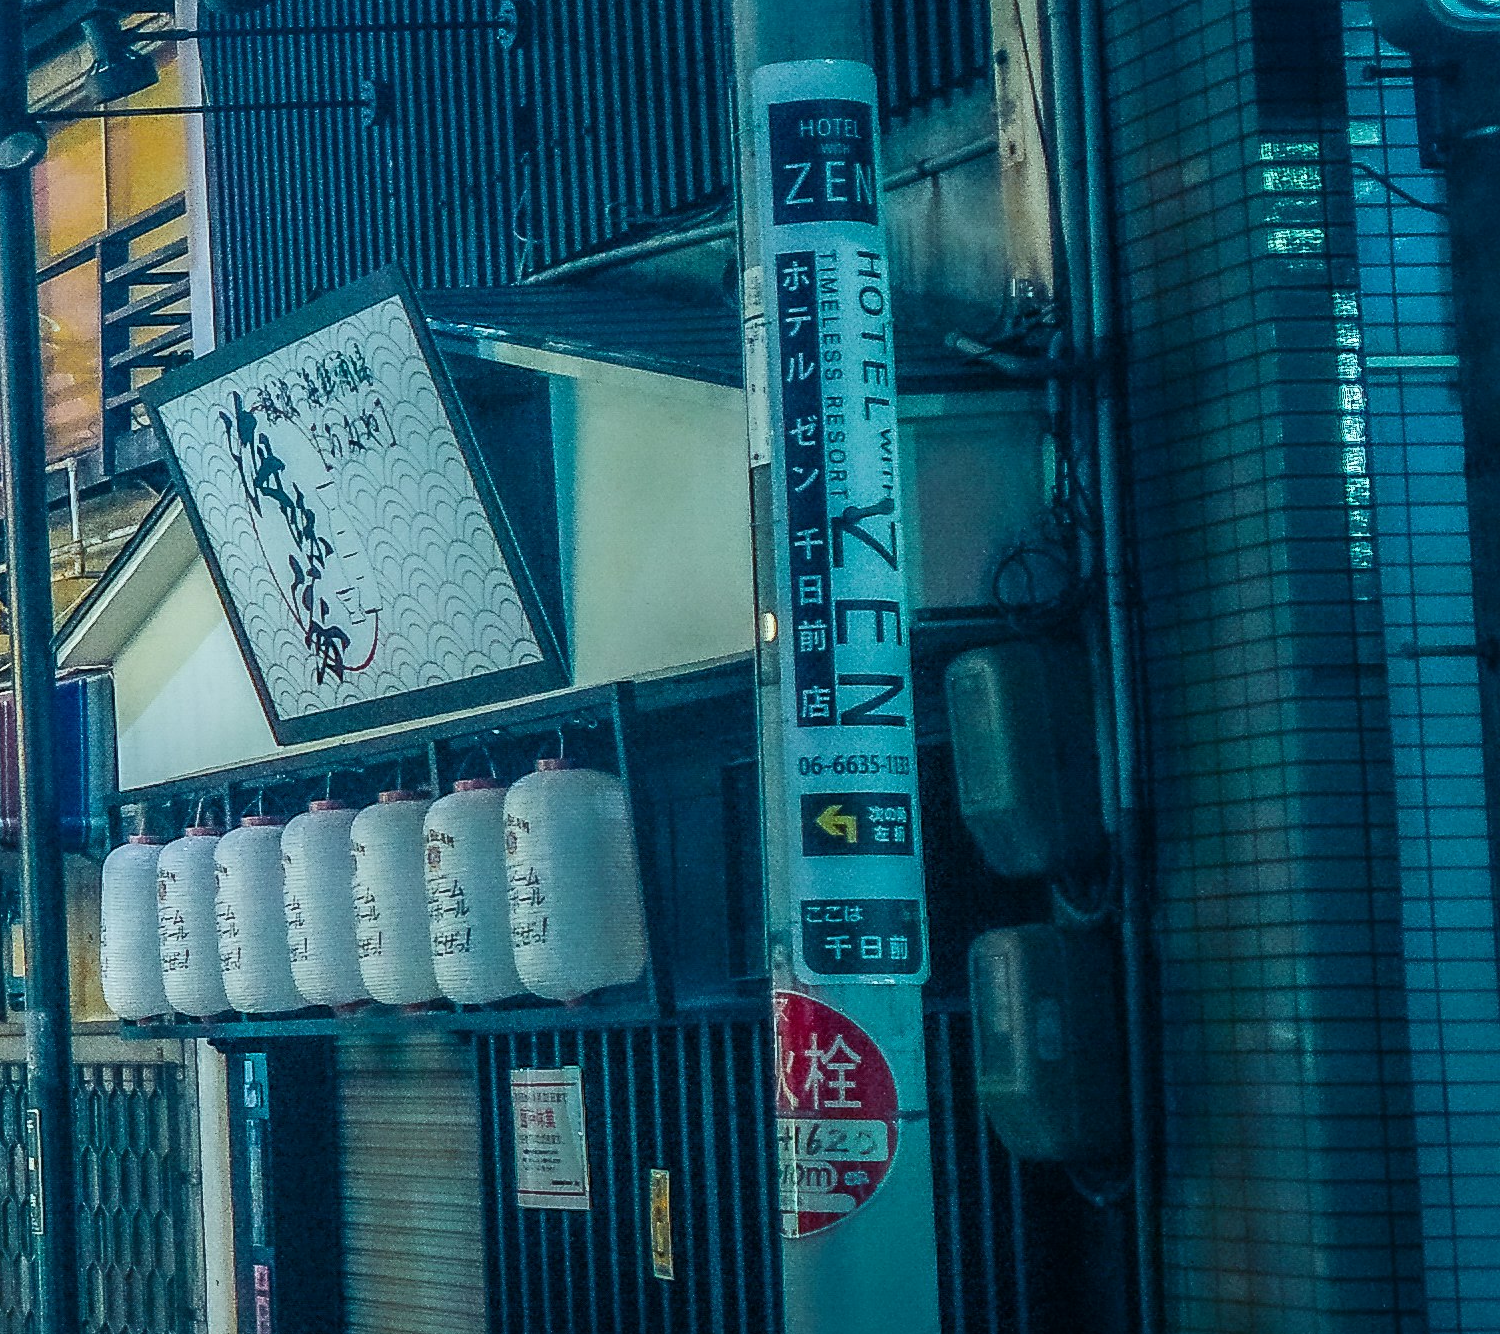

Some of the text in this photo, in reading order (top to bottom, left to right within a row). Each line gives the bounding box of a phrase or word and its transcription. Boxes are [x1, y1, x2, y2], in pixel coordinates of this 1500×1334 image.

[800, 117, 862, 139] HOTEL
[783, 162, 875, 206] ZEN
[817, 249, 849, 501] TIMELESS RESORT
[856, 250, 891, 420] HOTEL
[831, 497, 907, 727] ZEN
[826, 936, 908, 960] 千日前
